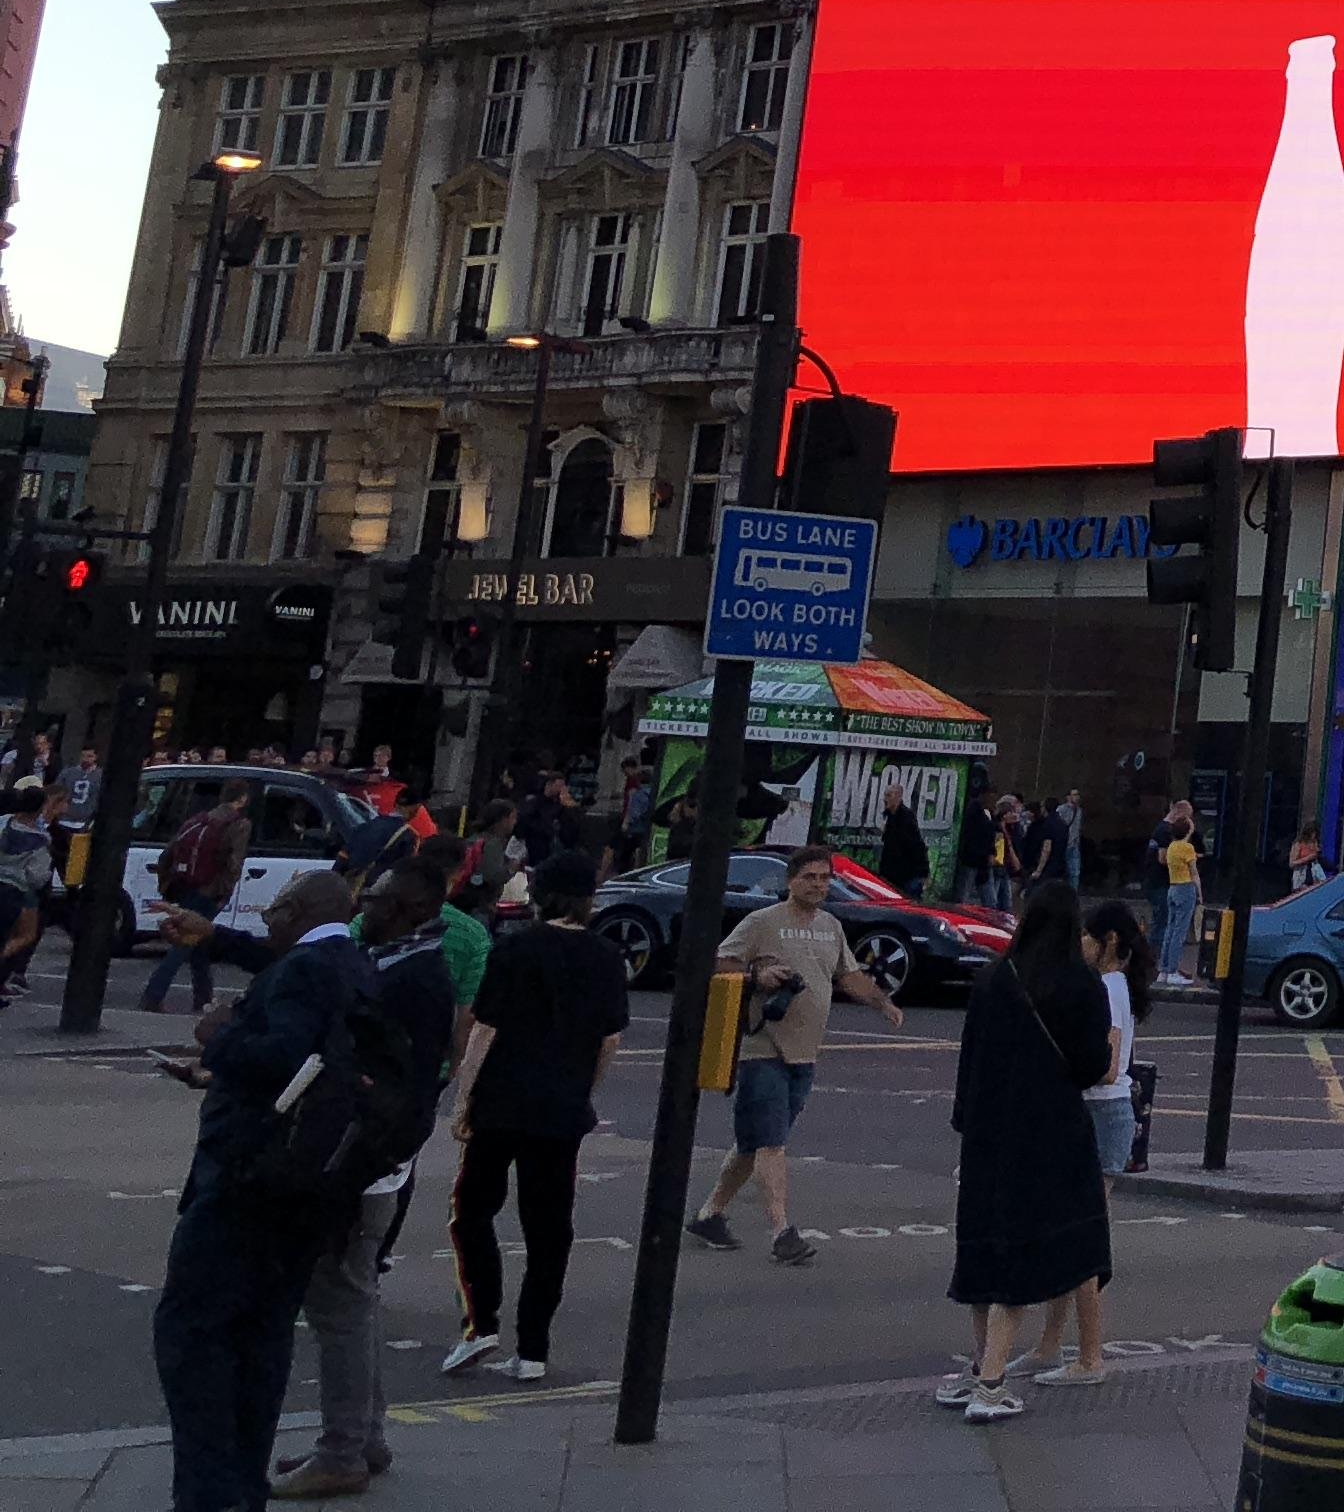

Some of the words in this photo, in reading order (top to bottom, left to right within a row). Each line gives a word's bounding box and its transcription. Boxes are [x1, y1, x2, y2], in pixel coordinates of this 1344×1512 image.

[739, 519, 788, 542] BUS
[796, 525, 857, 548] LANE
[991, 516, 1180, 560] BARCLAY
[544, 573, 595, 606] BAR
[275, 605, 315, 617] VANINI
[720, 598, 784, 622] LOOK
[793, 603, 856, 627] BOTH
[753, 630, 818, 653] WAYS
[645, 722, 700, 734] TICKETS
[748, 729, 772, 739] ALL
[783, 731, 829, 742] SHOWS
[880, 716, 903, 732] BEST
[905, 718, 935, 734] SHOW
[935, 721, 947, 735] IN
